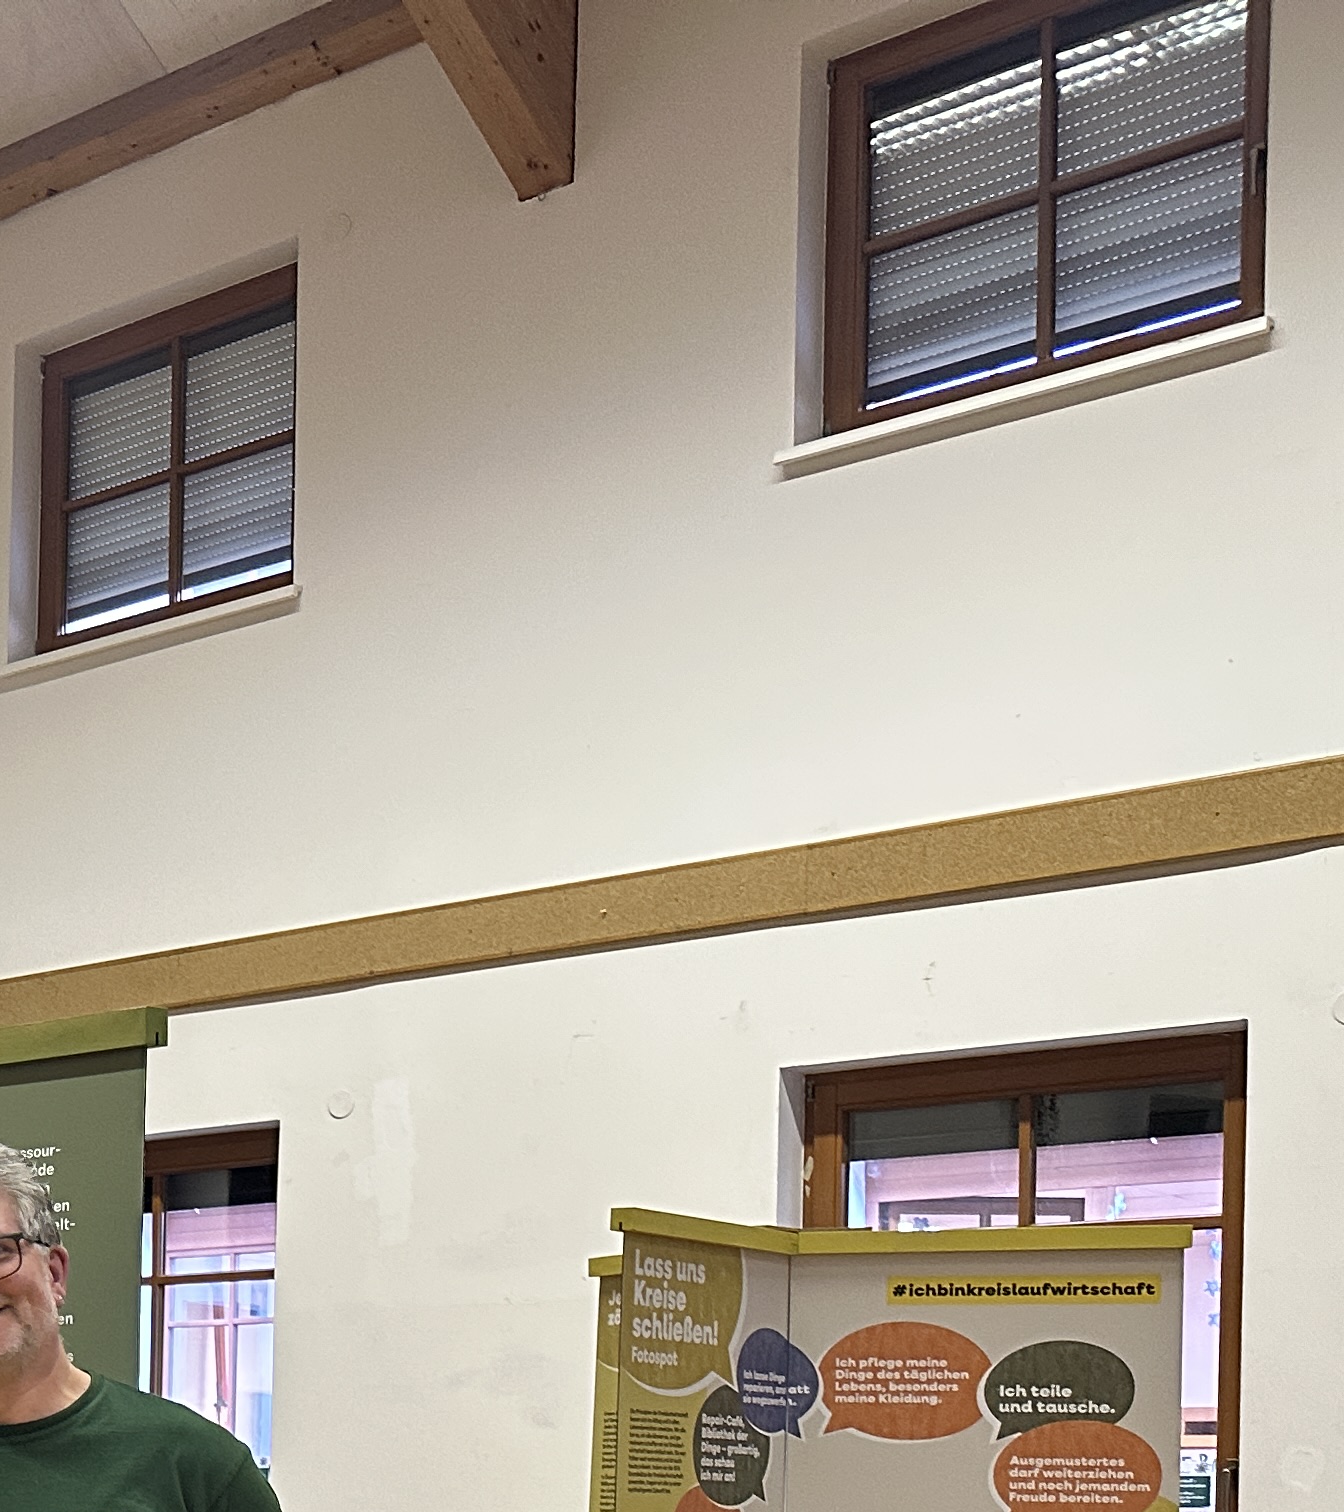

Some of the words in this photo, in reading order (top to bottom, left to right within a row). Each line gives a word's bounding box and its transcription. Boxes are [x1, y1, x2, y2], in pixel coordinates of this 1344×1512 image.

[634, 1248, 673, 1279] Lass
[676, 1260, 706, 1284] uns
[633, 1279, 687, 1312] Kreise
[892, 1281, 1156, 1297] #ichbinkreislaufwirtschaft
[632, 1311, 718, 1346] schließen!
[631, 1345, 678, 1369] Fotospot
[835, 1357, 856, 1368] Ich
[859, 1357, 904, 1370] pflege
[906, 1358, 948, 1368] meine
[835, 1369, 874, 1381] Dinge
[876, 1370, 900, 1380] des
[904, 1369, 970, 1382] täglichen
[835, 1382, 886, 1393] Lebens,
[889, 1382, 959, 1392] besonders
[999, 1384, 1027, 1398] Ich
[1030, 1384, 1073, 1399] teile
[834, 1394, 876, 1403] meine
[878, 1394, 942, 1406] Kleidung.
[998, 1399, 1033, 1414] und
[1036, 1400, 1116, 1414] tausche.
[701, 1427, 736, 1441] Bibliothek
[736, 1428, 749, 1441] der
[701, 1441, 721, 1455] Dinge
[700, 1455, 714, 1467] das
[714, 1457, 735, 1468] schau
[1009, 1455, 1126, 1468] Ausgemustertes
[700, 1468, 712, 1481] ich
[712, 1470, 723, 1482] mir
[1008, 1467, 1039, 1478] darf
[1043, 1468, 1135, 1480] weiterziehen
[1008, 1479, 1035, 1490] und
[1038, 1480, 1073, 1491] noch
[1074, 1480, 1151, 1493] jemandem
[1008, 1492, 1057, 1503] Freude
[1059, 1492, 1124, 1504] bereiten.
